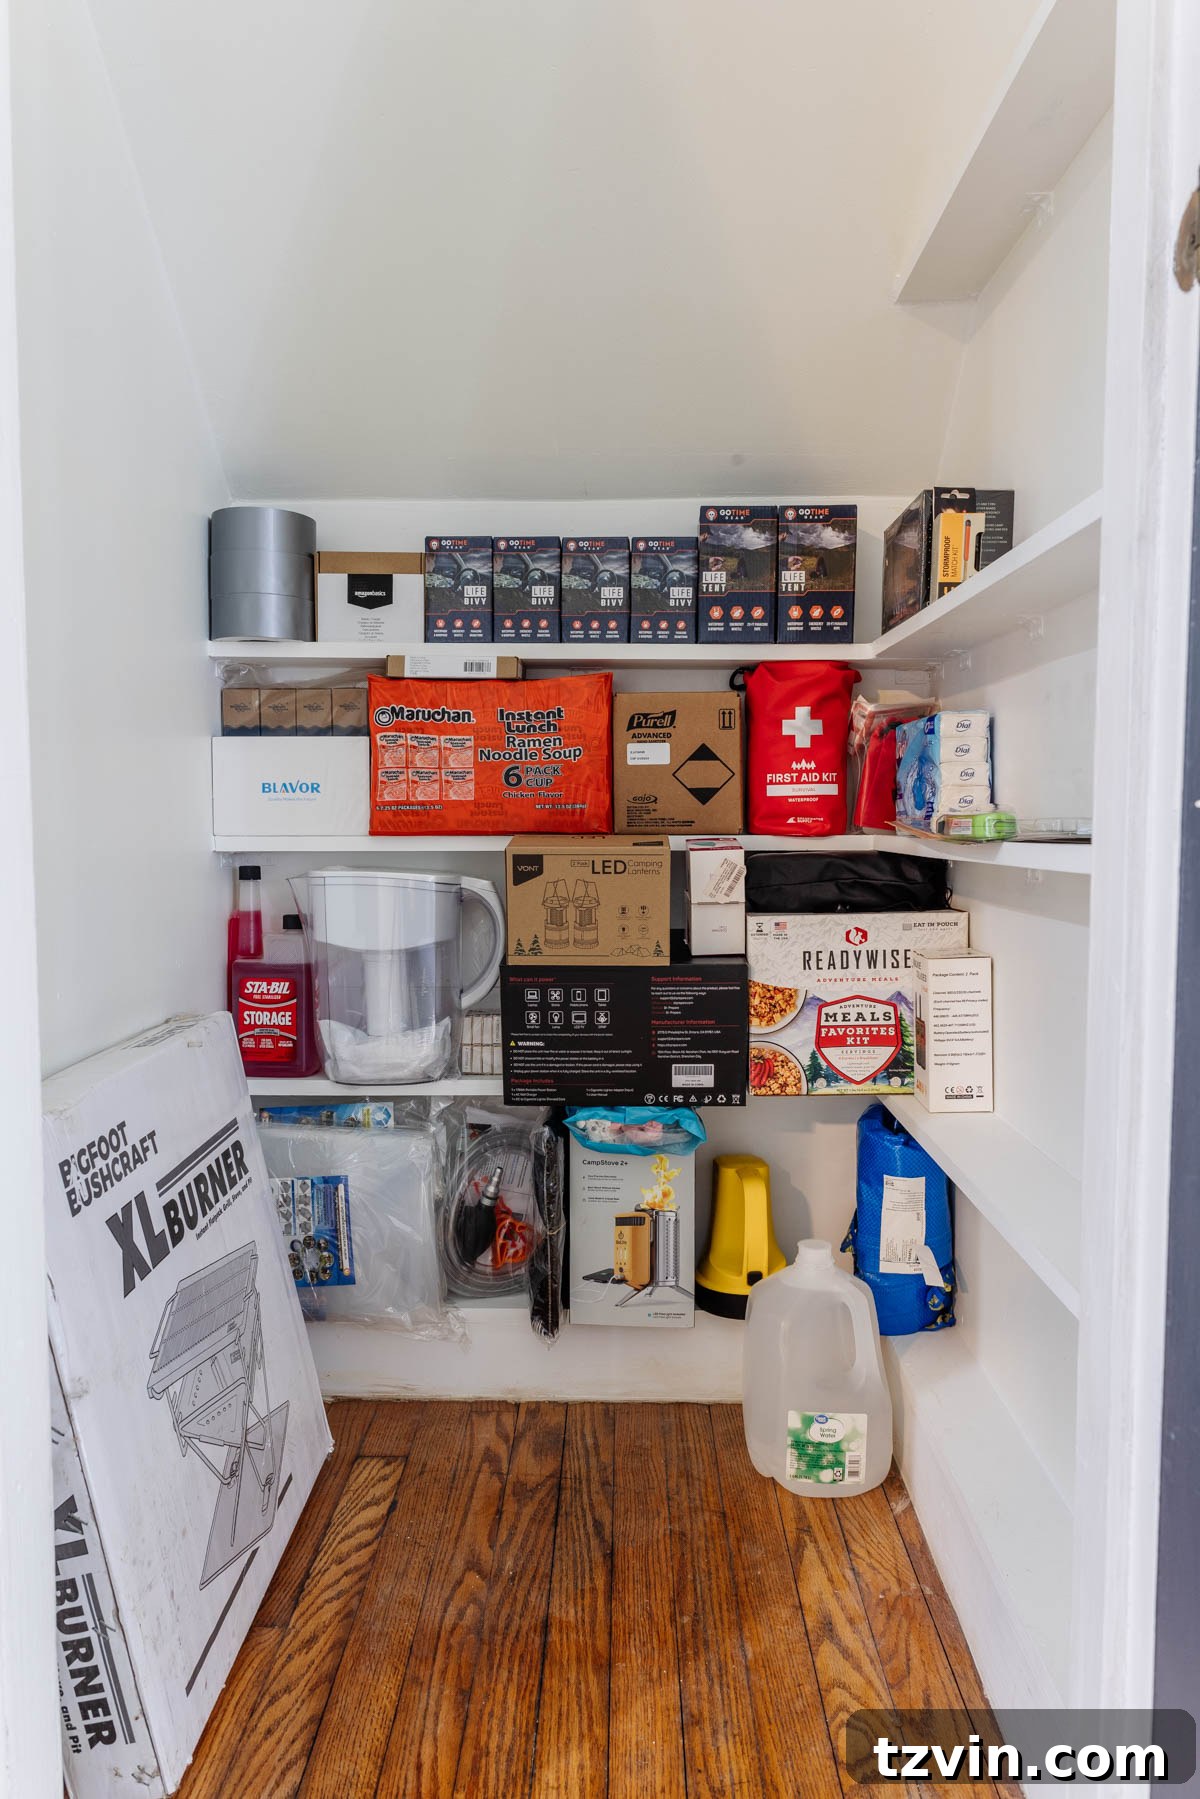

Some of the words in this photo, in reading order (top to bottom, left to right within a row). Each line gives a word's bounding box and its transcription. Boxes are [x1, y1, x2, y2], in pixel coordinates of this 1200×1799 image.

[943, 536, 951, 578] STORMPROOF
[951, 558, 959, 578] MATCH
[704, 572, 725, 582] LIFE
[783, 572, 804, 582] LIFE
[465, 586, 486, 597] LIFE
[532, 586, 554, 597] LIFE
[602, 588, 623, 598] LIFE
[670, 588, 692, 598] LIFE
[703, 584, 726, 592] TENT
[782, 583, 805, 592] TENT
[354, 590, 386, 598] amazonbasics
[464, 598, 487, 606] BIVY
[532, 598, 554, 606] BIVY
[390, 704, 472, 723] Maruchan
[497, 706, 564, 724] Instant
[632, 712, 672, 727] Purell
[506, 720, 558, 734] Lunch
[506, 735, 563, 748] Ramen
[478, 747, 538, 762] Noodle
[542, 746, 582, 762] Soup
[503, 764, 522, 788] 6
[525, 766, 562, 776] PACK
[767, 773, 798, 783] FIRST
[800, 772, 820, 782] AID
[822, 772, 838, 782] KIT
[960, 770, 975, 778] Dial
[262, 780, 321, 794] BLAVOR
[526, 778, 554, 788] CUP
[592, 860, 626, 875] LED
[628, 859, 663, 870] Camping
[628, 868, 660, 876] Lanterns
[802, 949, 911, 970] READYWISE
[244, 982, 290, 994] STA-BIL
[244, 1011, 292, 1026] STORAGE
[824, 1012, 892, 1022] MEALS
[821, 1027, 896, 1036] FAVORITES
[846, 1036, 870, 1044] KIT
[58, 1120, 130, 1188] BIGFOOT
[66, 1130, 159, 1218] BUSHCRAFT
[105, 1190, 170, 1299] XL
[162, 1140, 249, 1249] BURNER
[56, 1577, 118, 1751] BURNER
[61, 1706, 77, 1731] and
[69, 1735, 82, 1754] Pit
